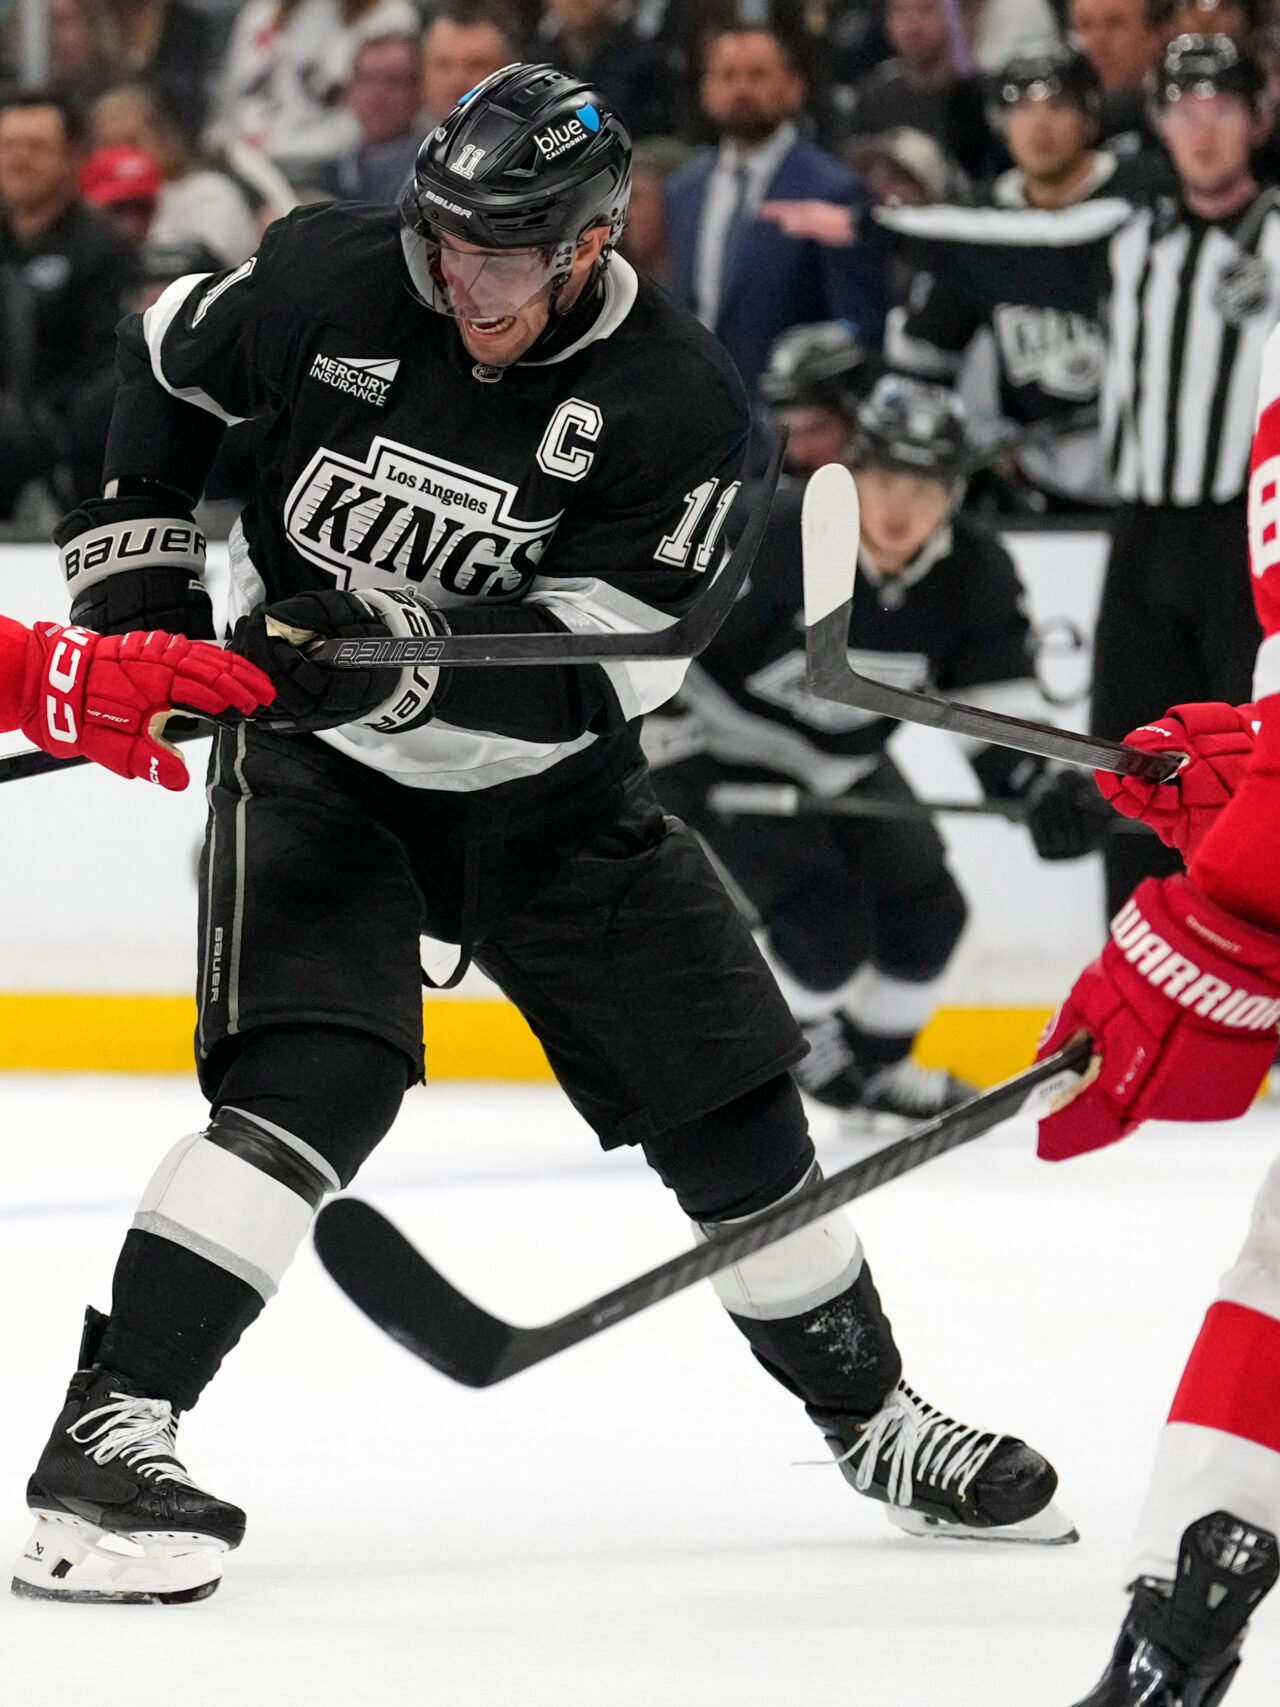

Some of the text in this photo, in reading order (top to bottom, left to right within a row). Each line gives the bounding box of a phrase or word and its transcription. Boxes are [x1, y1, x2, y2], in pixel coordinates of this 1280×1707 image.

[533, 119, 583, 154] blue
[545, 133, 588, 161] CALIFORNIA
[450, 144, 486, 180] 11
[309, 365, 387, 406] INSURANCE
[313, 353, 391, 395] MERCURY
[536, 397, 603, 482] C
[386, 465, 488, 515] Los Angeles
[299, 474, 554, 597] KINGS
[653, 477, 741, 573] 11
